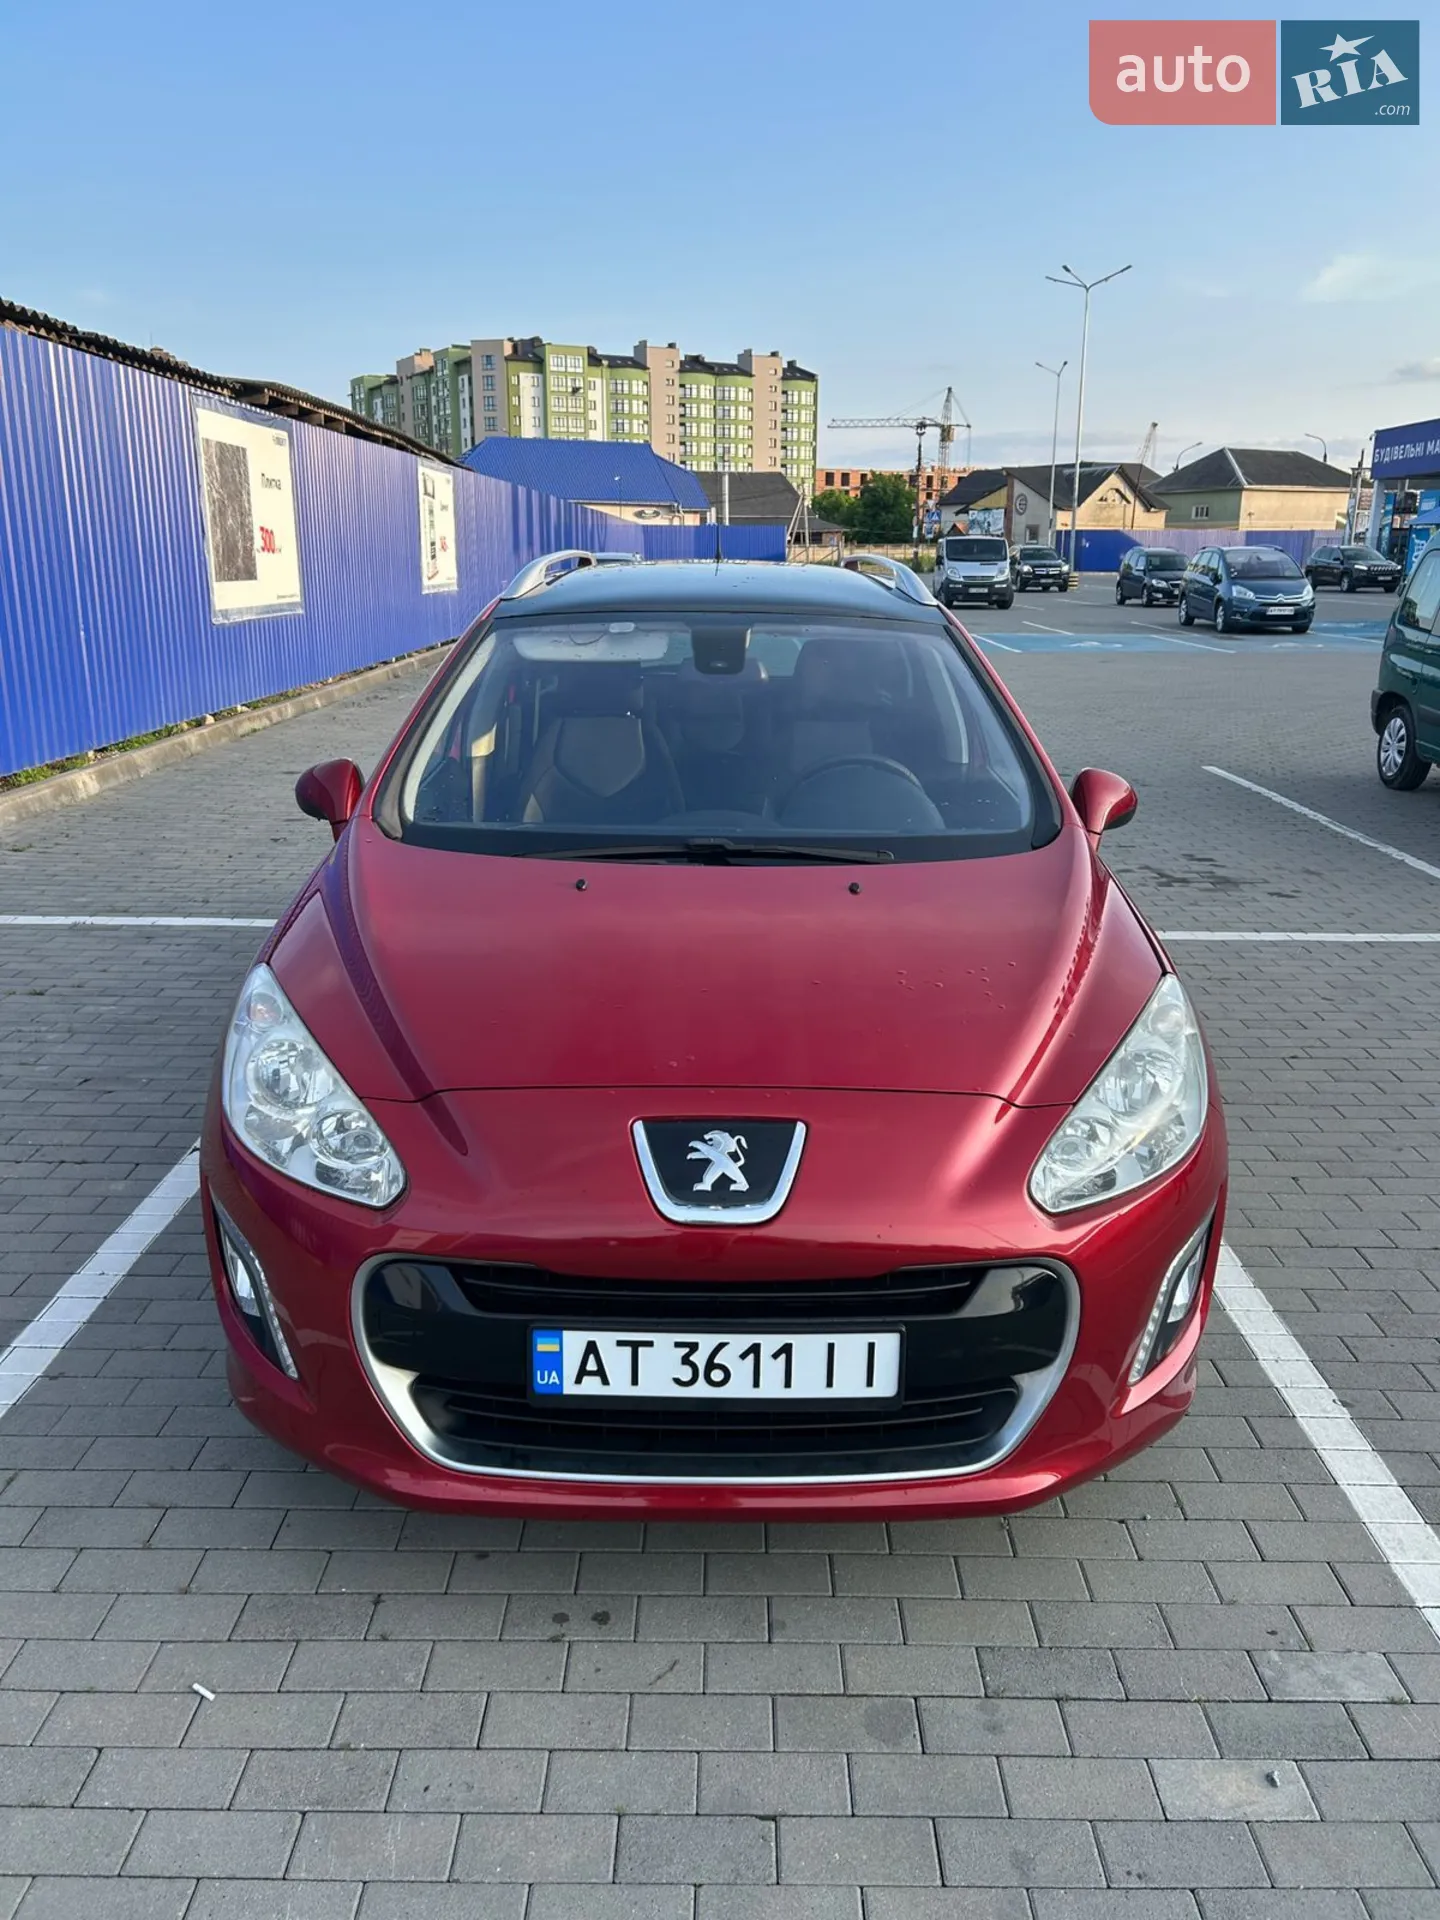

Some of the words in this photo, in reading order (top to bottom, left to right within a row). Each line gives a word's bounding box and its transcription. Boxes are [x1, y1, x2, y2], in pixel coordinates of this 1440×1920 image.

[1374, 441, 1425, 464] БУДІВЕЛЬНІ
[574, 1340, 654, 1387] AT
[672, 1341, 794, 1389] 3611
[537, 1370, 560, 1385] UA
